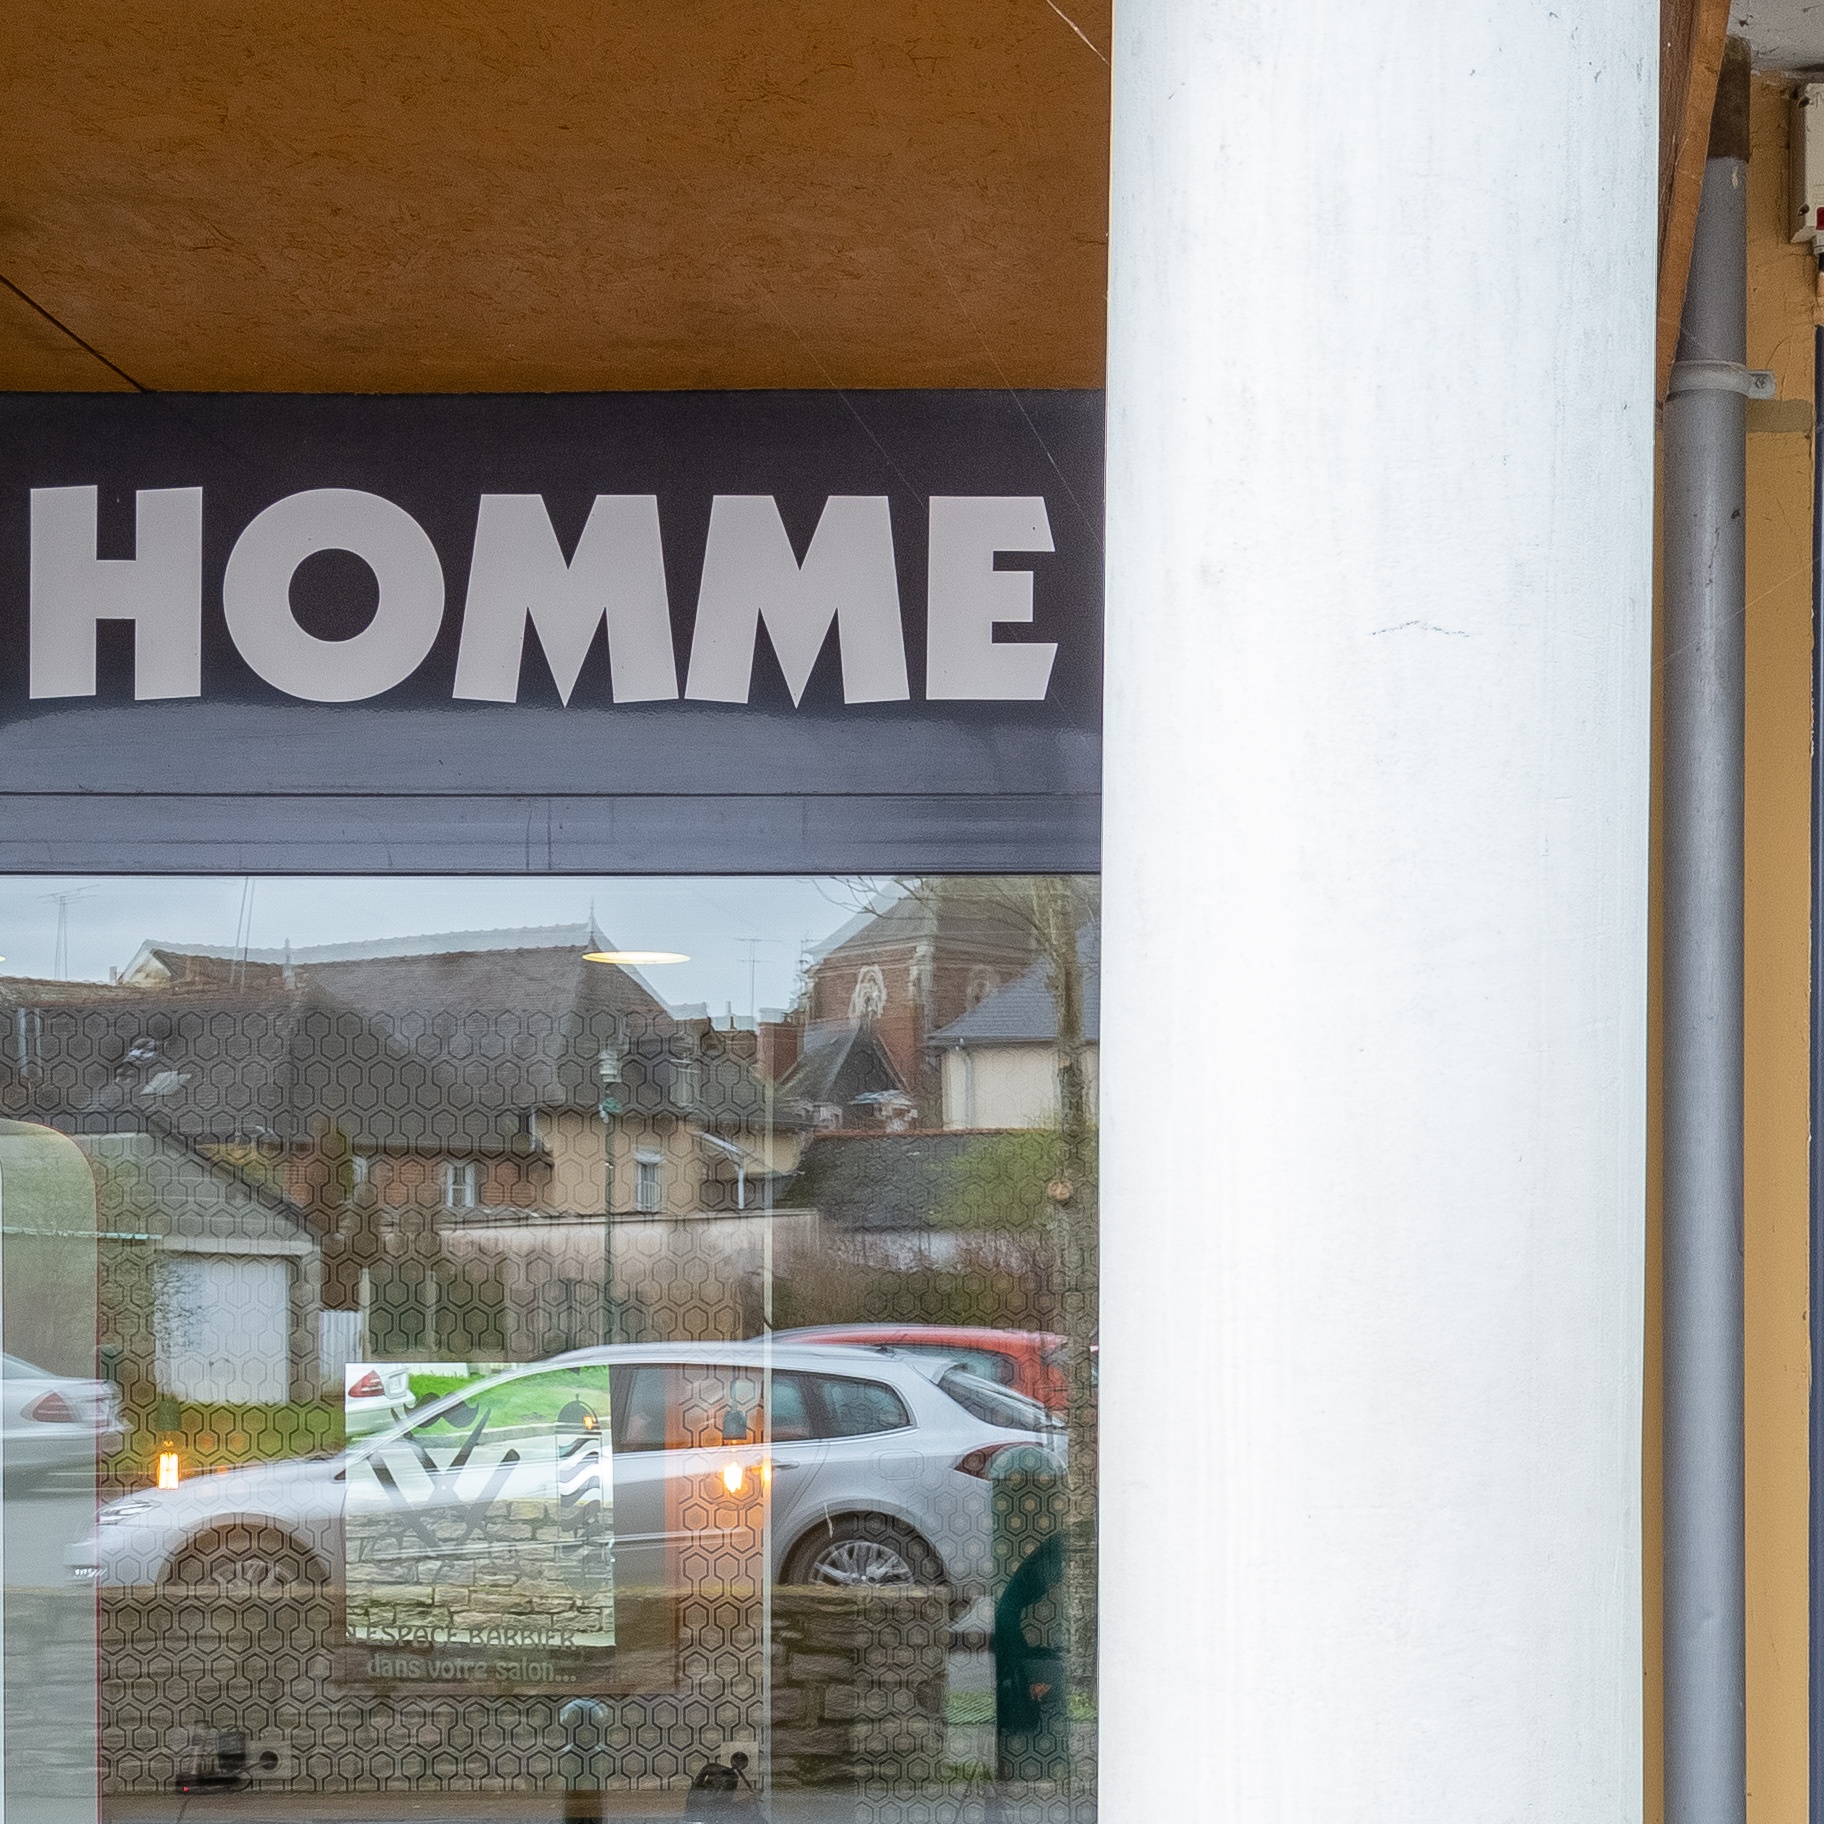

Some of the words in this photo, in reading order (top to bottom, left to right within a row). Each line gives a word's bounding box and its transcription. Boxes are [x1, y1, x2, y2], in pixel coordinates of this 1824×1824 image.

[28, 484, 1060, 709] HOMME
[468, 1627, 577, 1650] BARBIER
[367, 1652, 422, 1679] dans
[427, 1657, 488, 1681] votre
